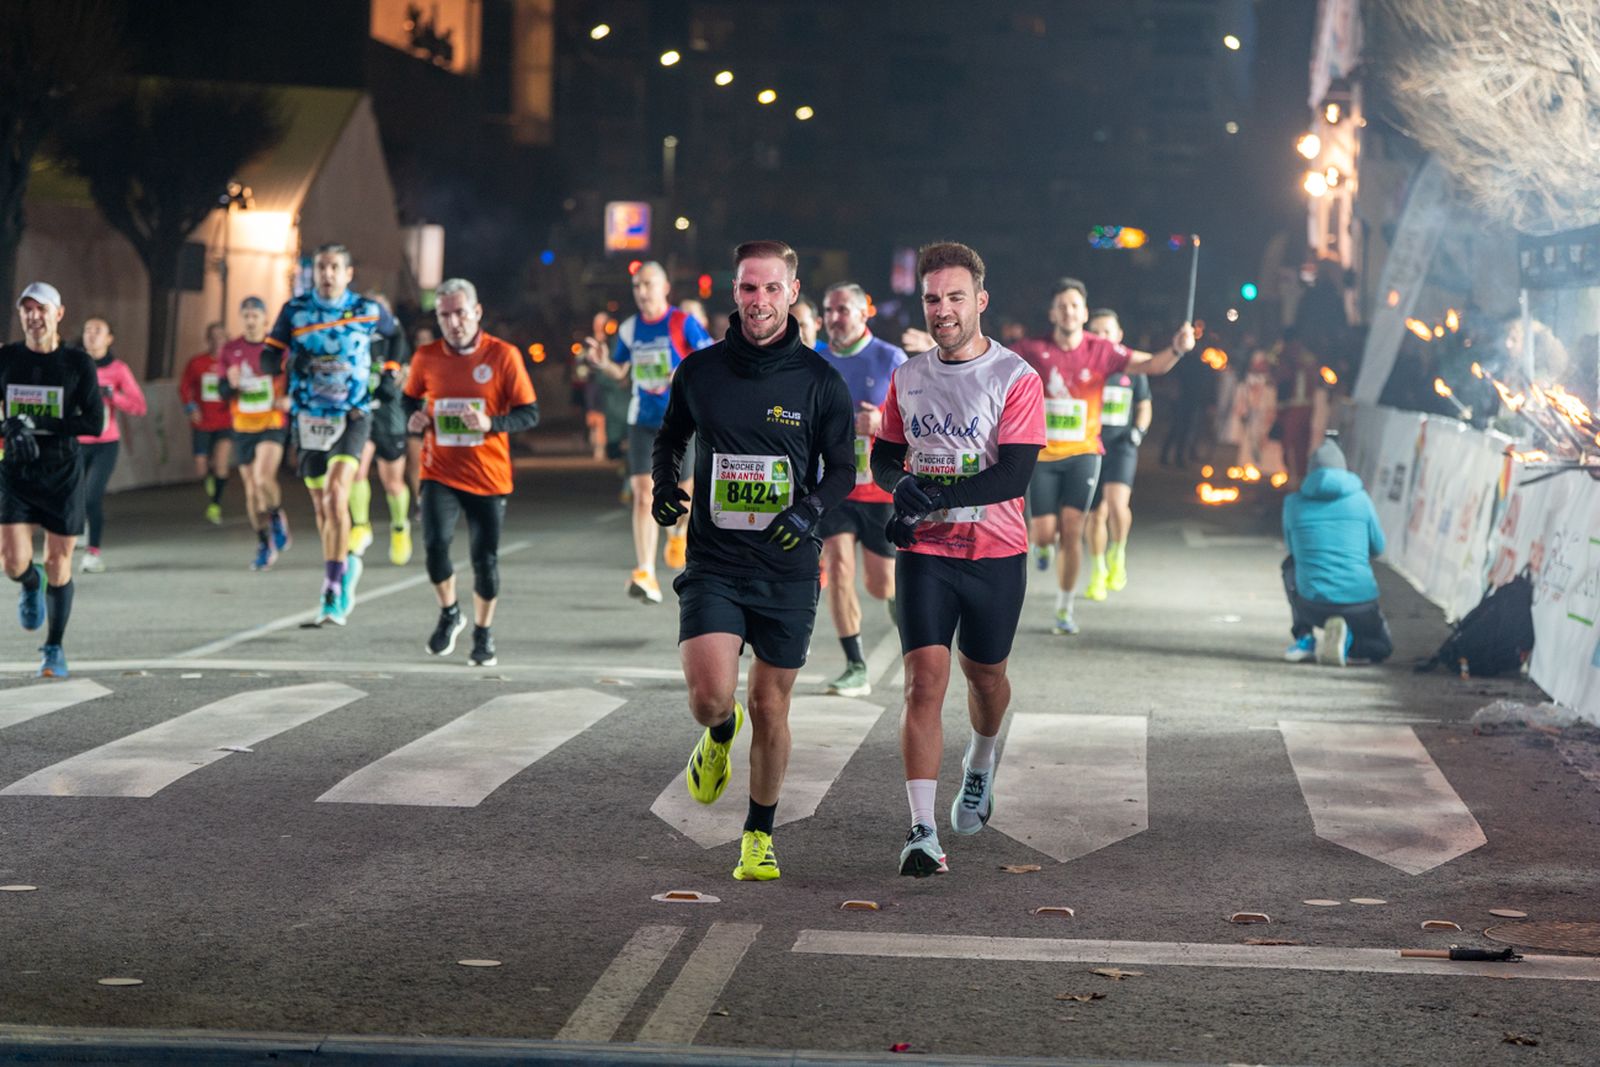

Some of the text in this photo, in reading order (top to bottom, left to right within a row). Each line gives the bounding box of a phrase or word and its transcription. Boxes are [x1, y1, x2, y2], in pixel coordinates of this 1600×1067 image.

[767, 406, 801, 420] FOCUS
[766, 417, 801, 427] FITNESS
[921, 413, 980, 439] Salud
[730, 463, 765, 471] NOCHE DE
[720, 471, 736, 480] SAN
[727, 481, 779, 504] 8424
